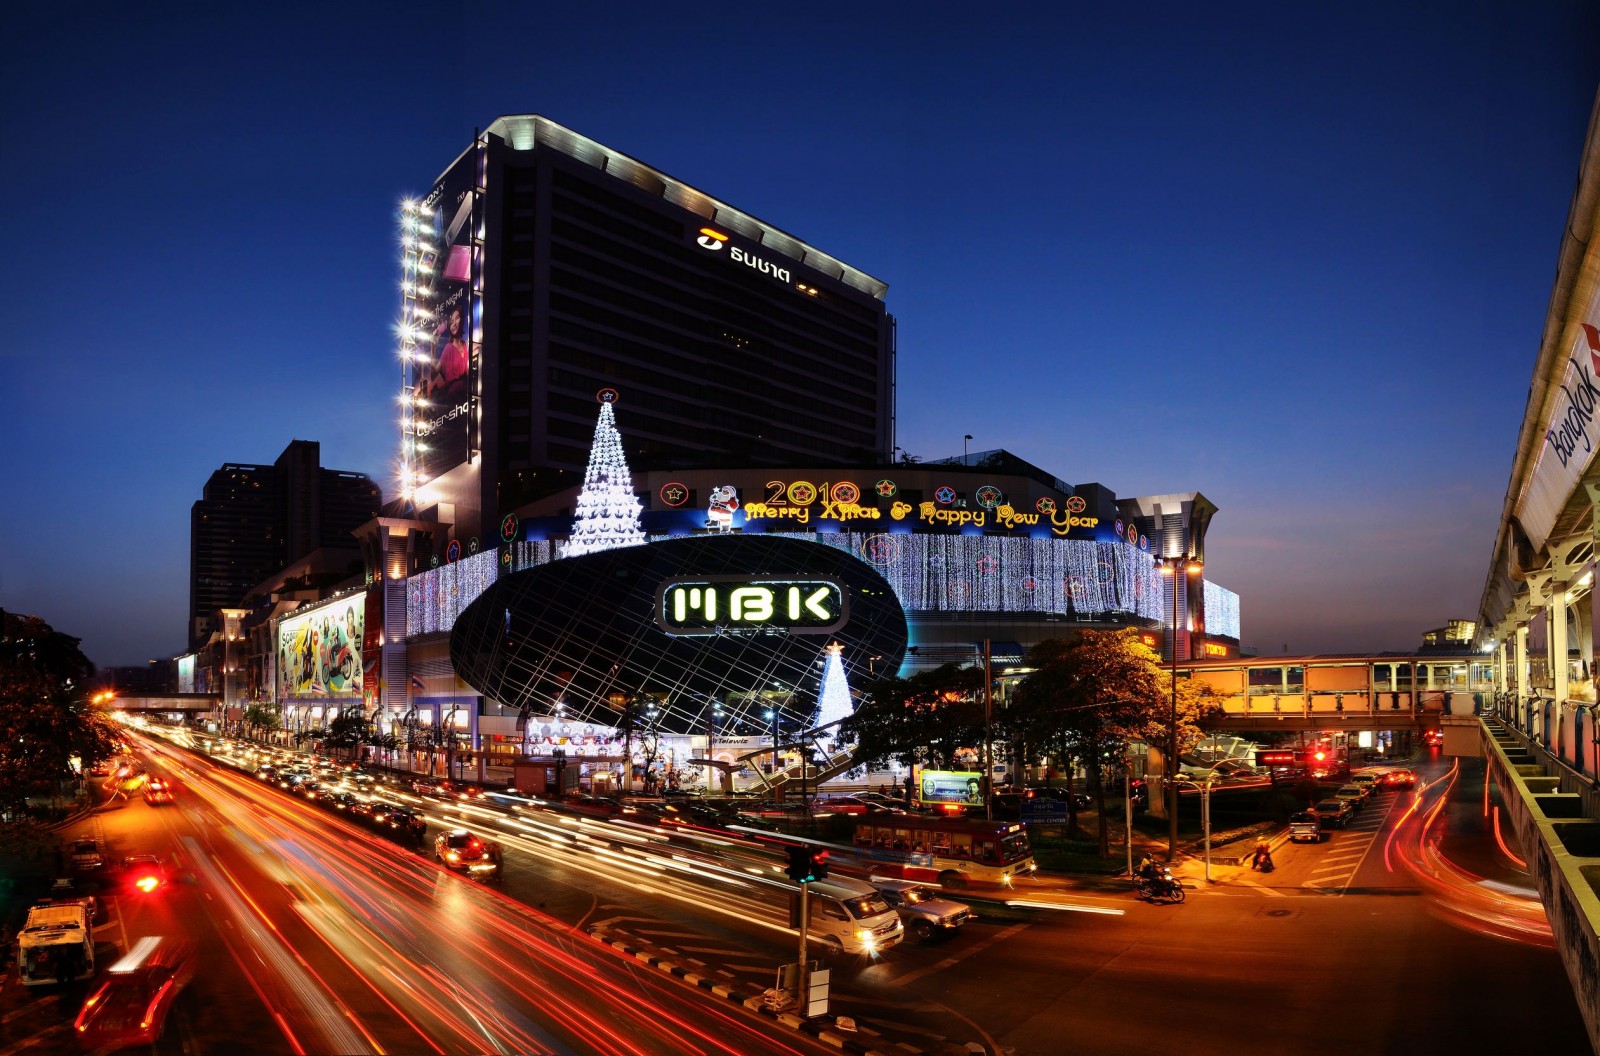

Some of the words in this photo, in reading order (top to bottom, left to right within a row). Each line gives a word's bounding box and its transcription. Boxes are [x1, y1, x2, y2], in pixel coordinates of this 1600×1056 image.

[730, 246, 790, 283] ธนชาต
[1549, 358, 1600, 469] Bangkok
[765, 480, 860, 505] 2010
[744, 502, 809, 523] Merry
[890, 501, 912, 520] &
[918, 501, 985, 527] Happy
[996, 504, 1039, 528] New
[1051, 508, 1098, 535] Year
[674, 587, 831, 622] MBK
